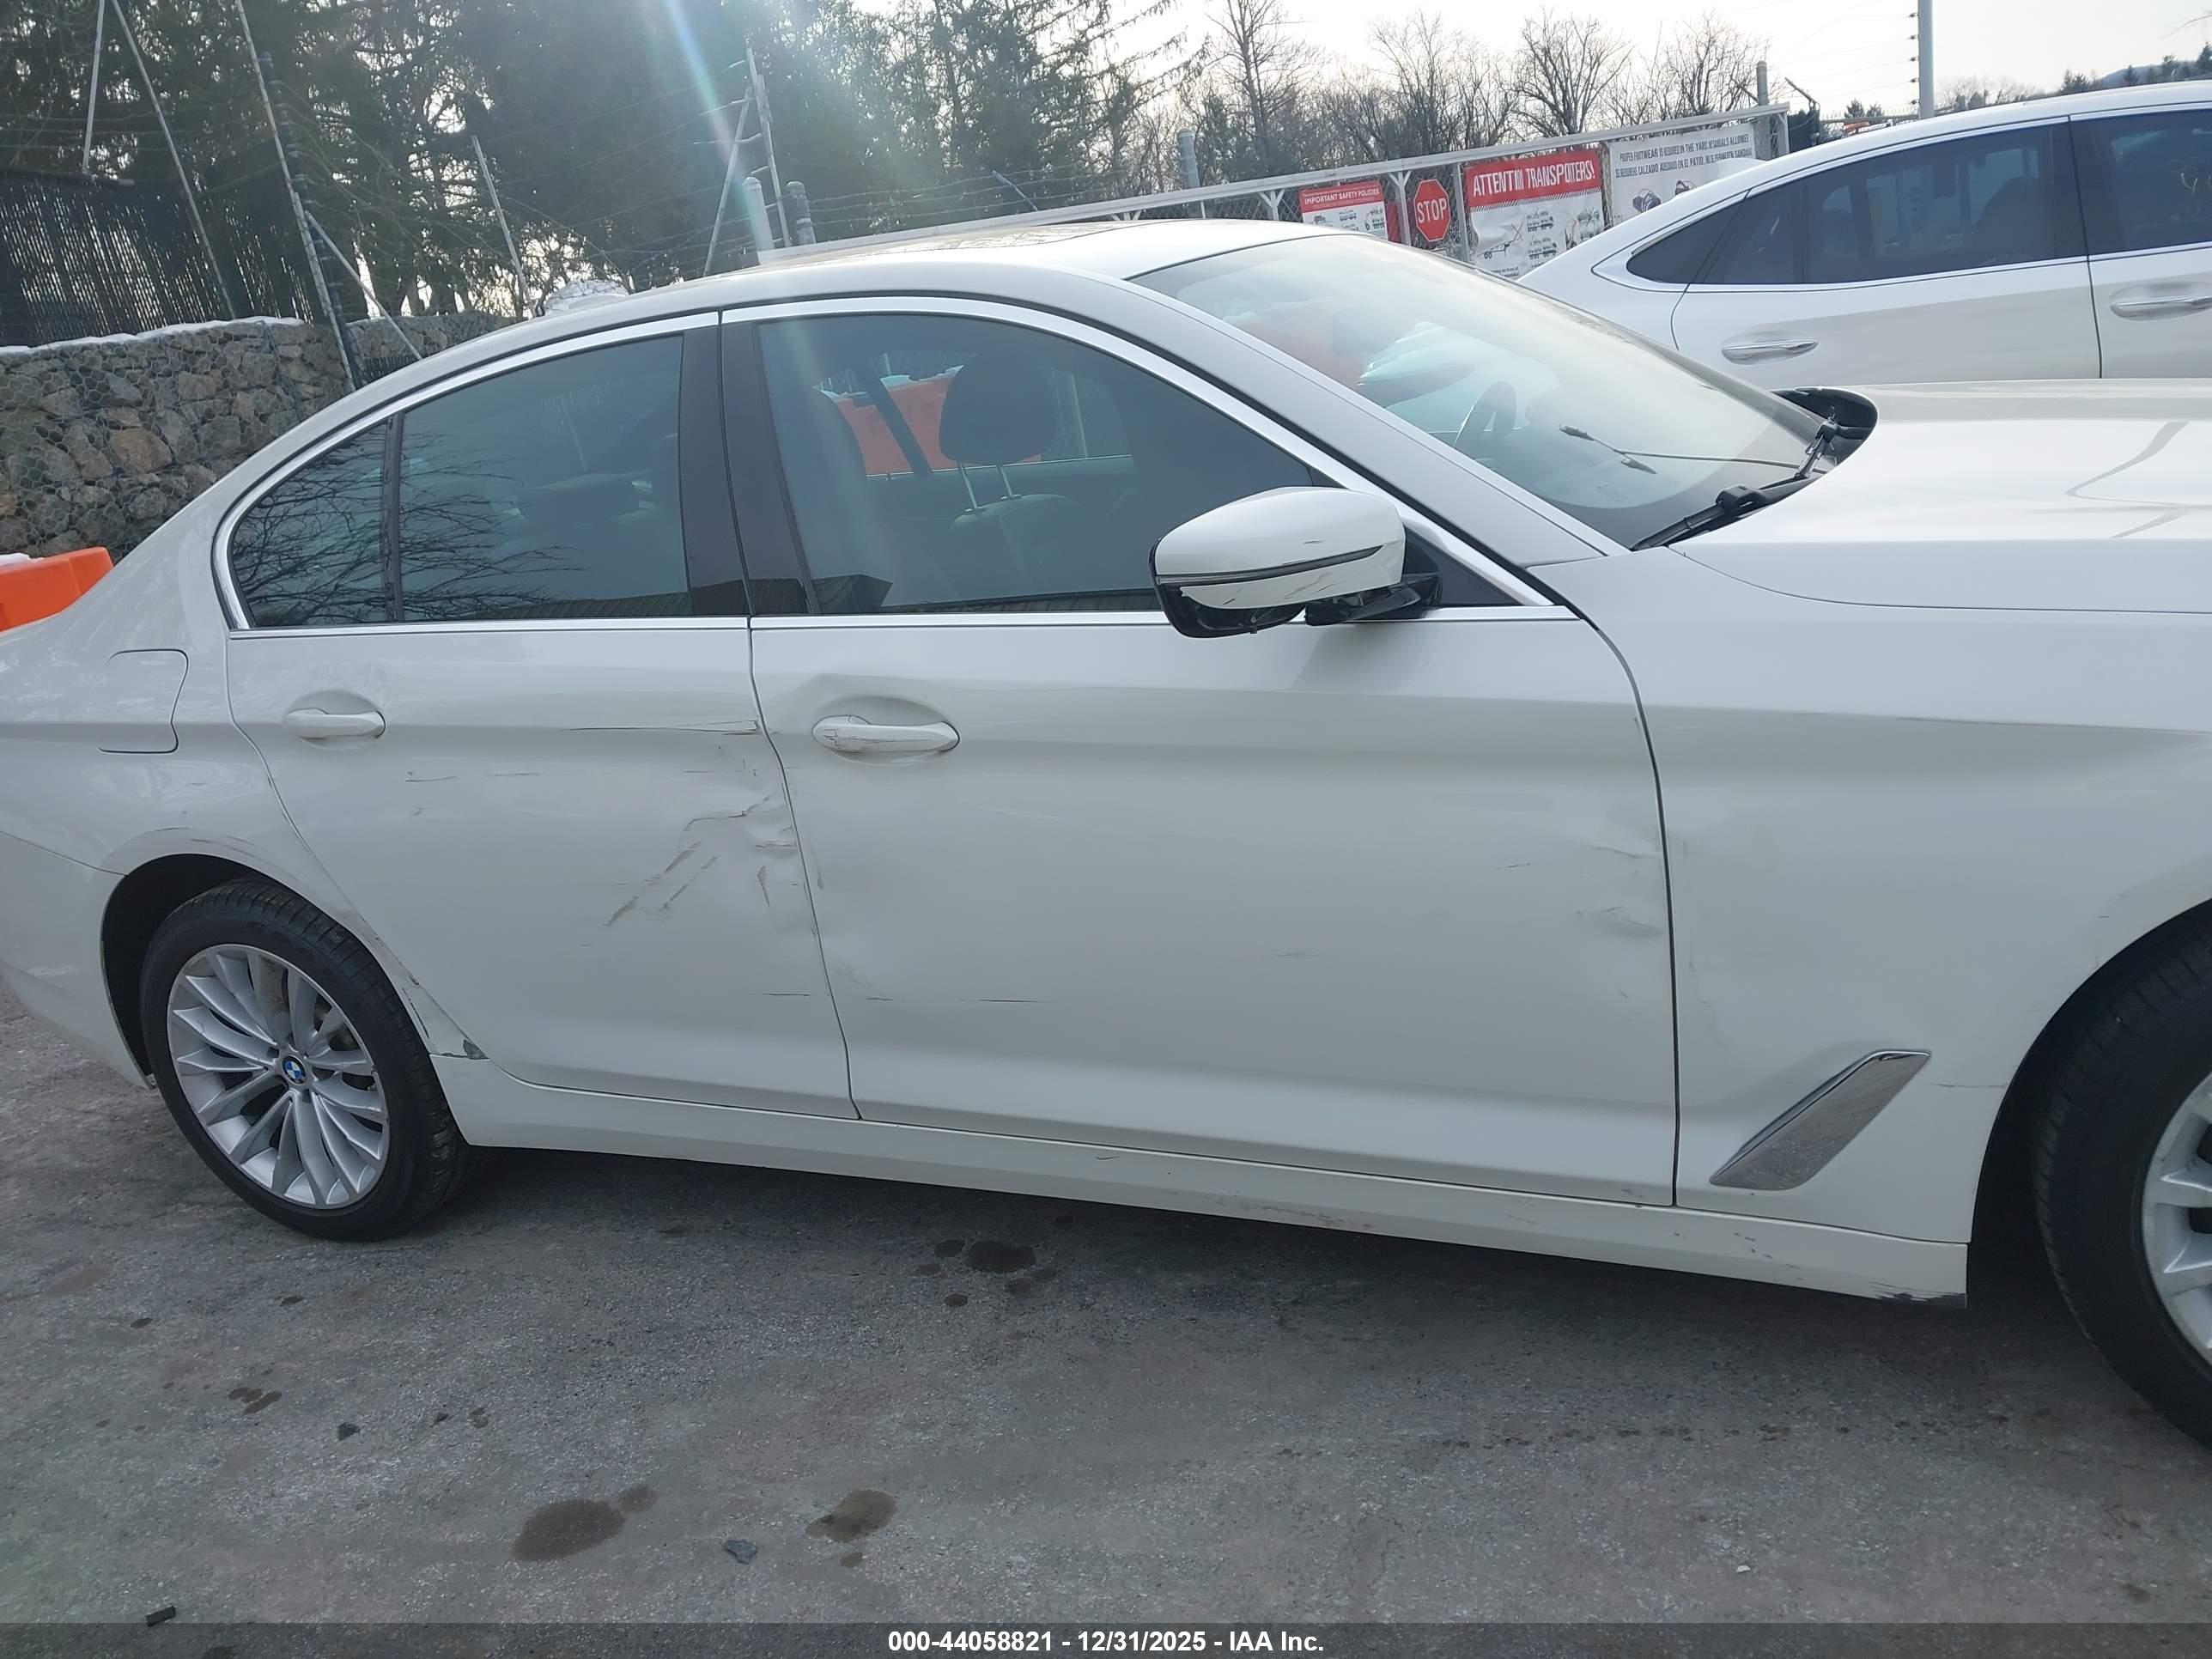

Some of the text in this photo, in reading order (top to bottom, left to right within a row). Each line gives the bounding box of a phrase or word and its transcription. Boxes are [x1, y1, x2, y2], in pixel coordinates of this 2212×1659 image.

[1685, 143, 1694, 153] THE
[1638, 163, 1659, 176] CALZADO
[1304, 193, 1338, 205] IMPORTANT
[1339, 191, 1358, 200] SAFETY
[1358, 188, 1380, 198] POLICIES
[1417, 198, 1447, 224] STOP
